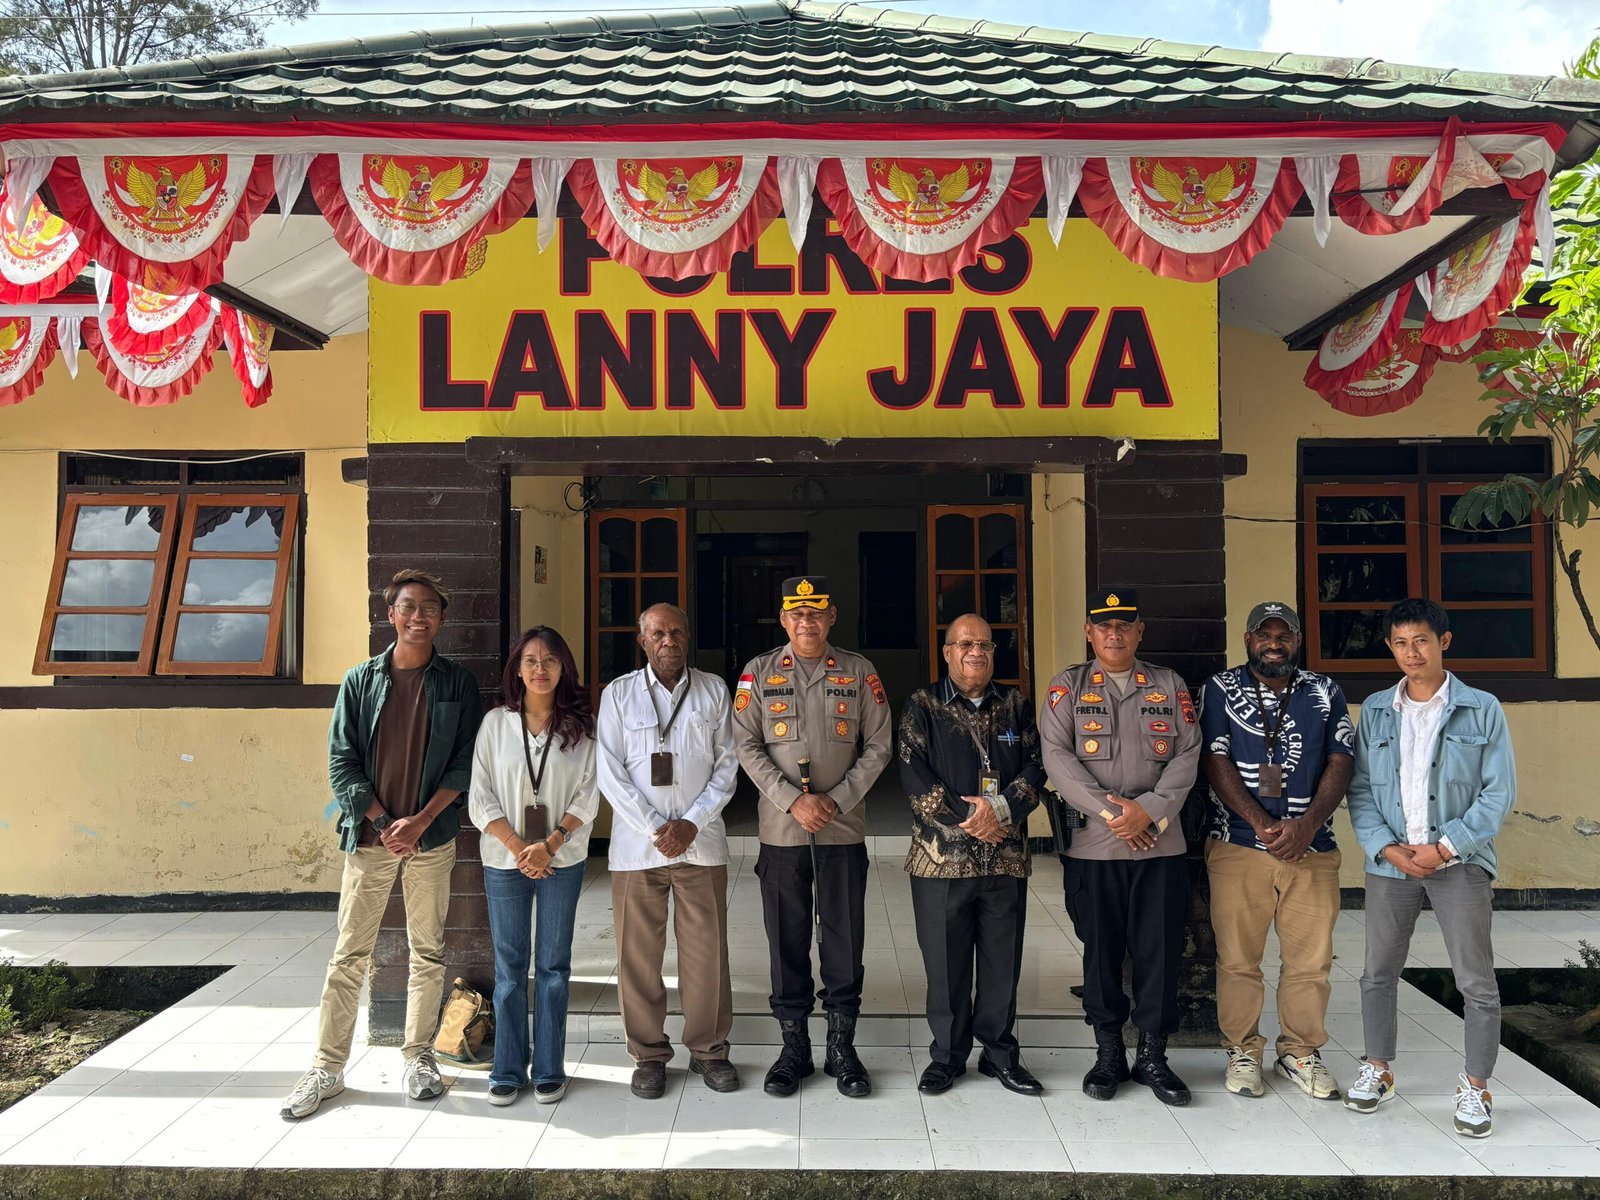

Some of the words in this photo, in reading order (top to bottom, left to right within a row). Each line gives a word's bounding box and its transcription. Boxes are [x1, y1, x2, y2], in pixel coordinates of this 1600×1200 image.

[419, 308, 837, 412] LANNY
[867, 306, 1174, 410] JAYA
[827, 688, 857, 698] POLRI
[1141, 706, 1173, 716] POLRI
